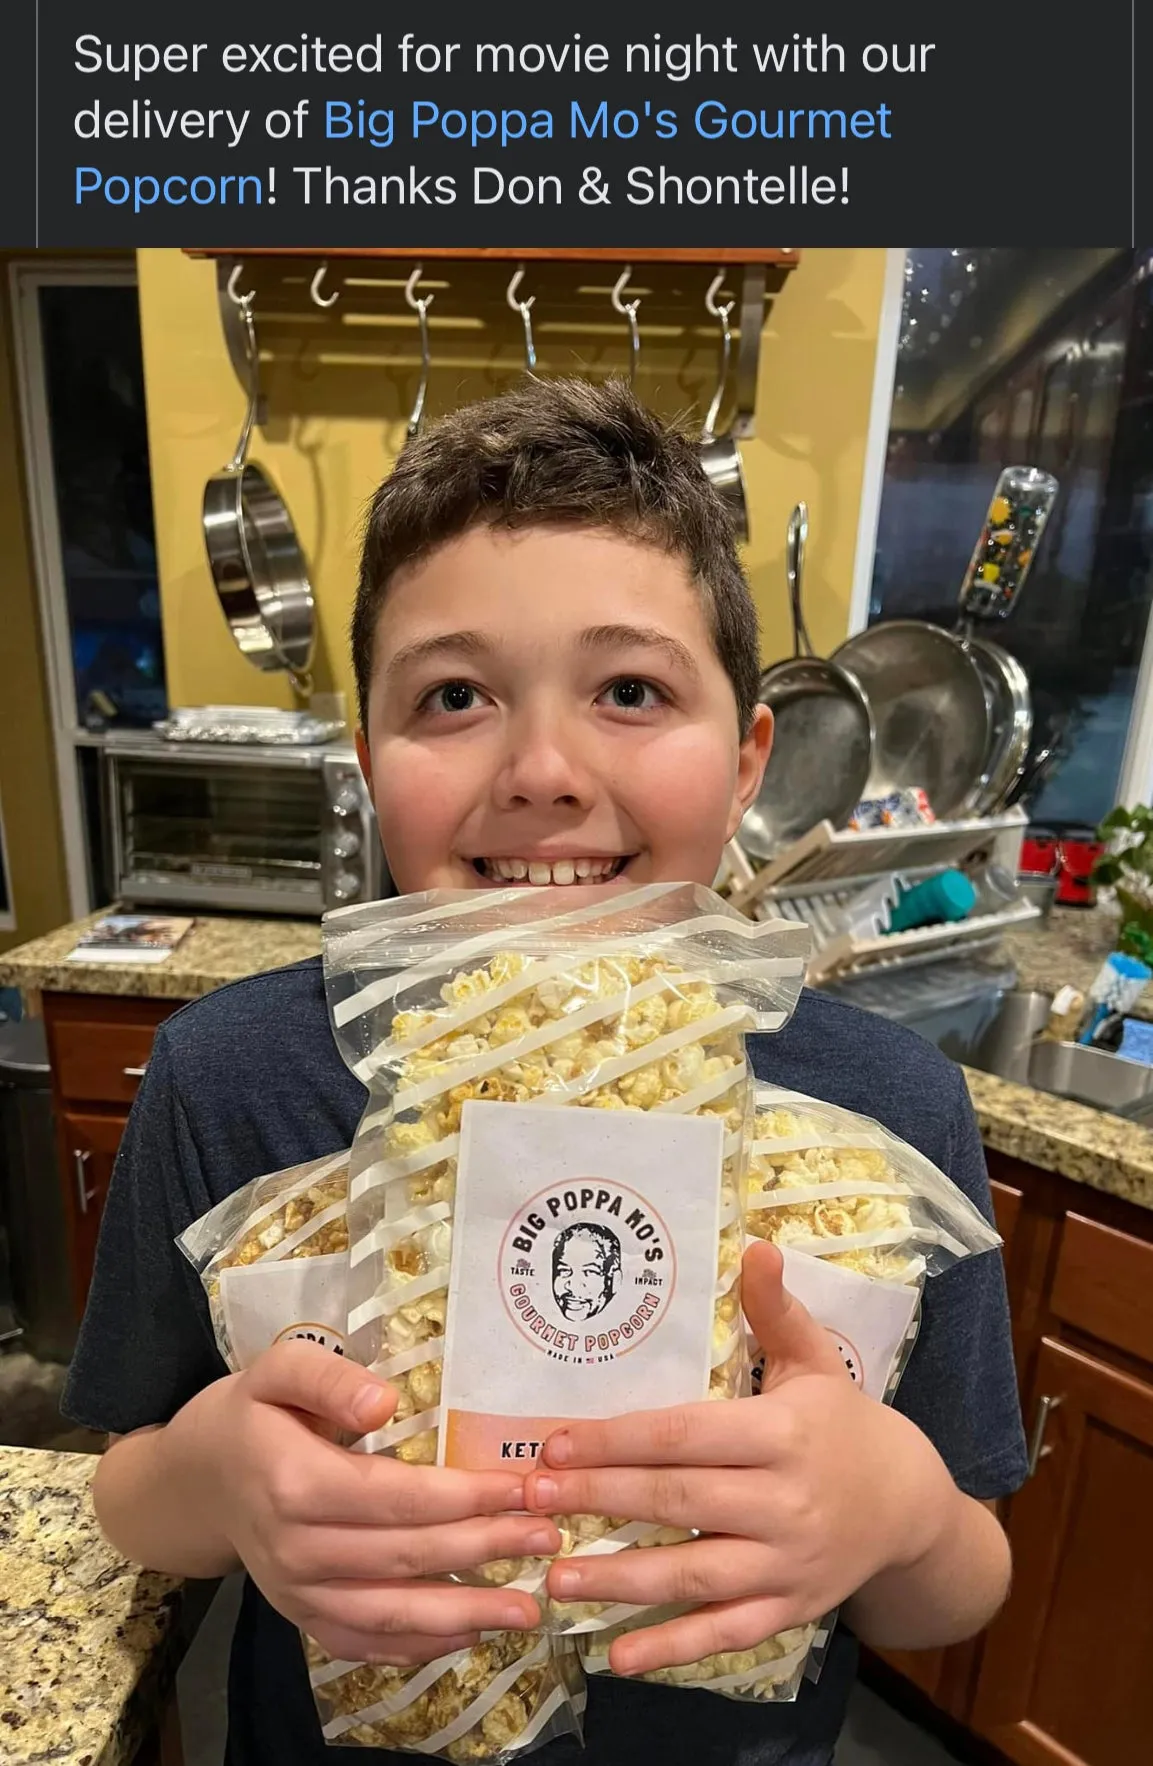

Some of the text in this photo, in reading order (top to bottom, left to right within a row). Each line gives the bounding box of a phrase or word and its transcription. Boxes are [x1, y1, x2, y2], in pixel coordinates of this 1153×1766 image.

[512, 1188, 664, 1262] BIG POPPA MO'S
[510, 1266, 536, 1277] TASTE
[634, 1276, 663, 1286] IMPACT
[510, 1283, 661, 1352] GOURMET POPCORN
[547, 1349, 569, 1362] MADE
[598, 1353, 614, 1363] USA
[501, 1442, 546, 1458] KET
